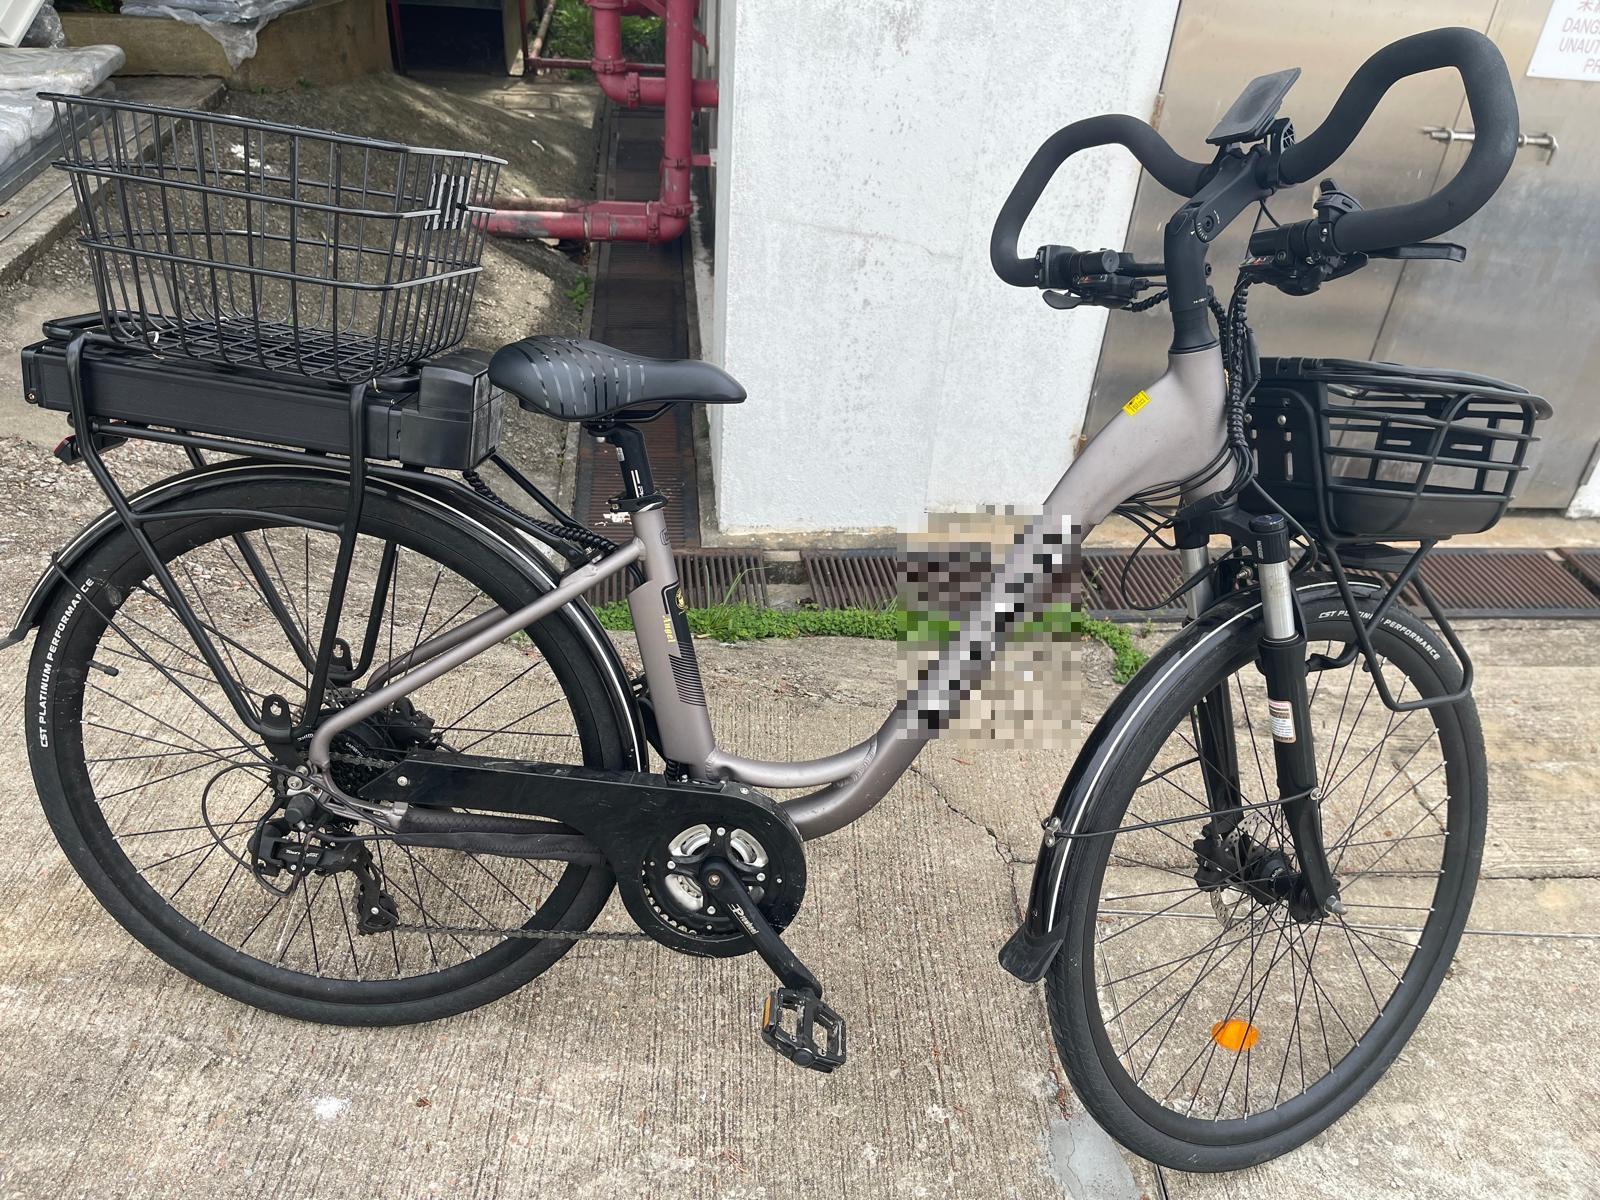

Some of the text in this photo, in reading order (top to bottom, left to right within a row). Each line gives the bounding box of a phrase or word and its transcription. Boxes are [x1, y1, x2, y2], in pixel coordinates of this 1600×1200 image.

[1562, 17, 1600, 35] DANG
[1383, 618, 1441, 661] PERFORMANCE
[39, 663, 52, 724] PLATINUM
[38, 727, 49, 747] CST
